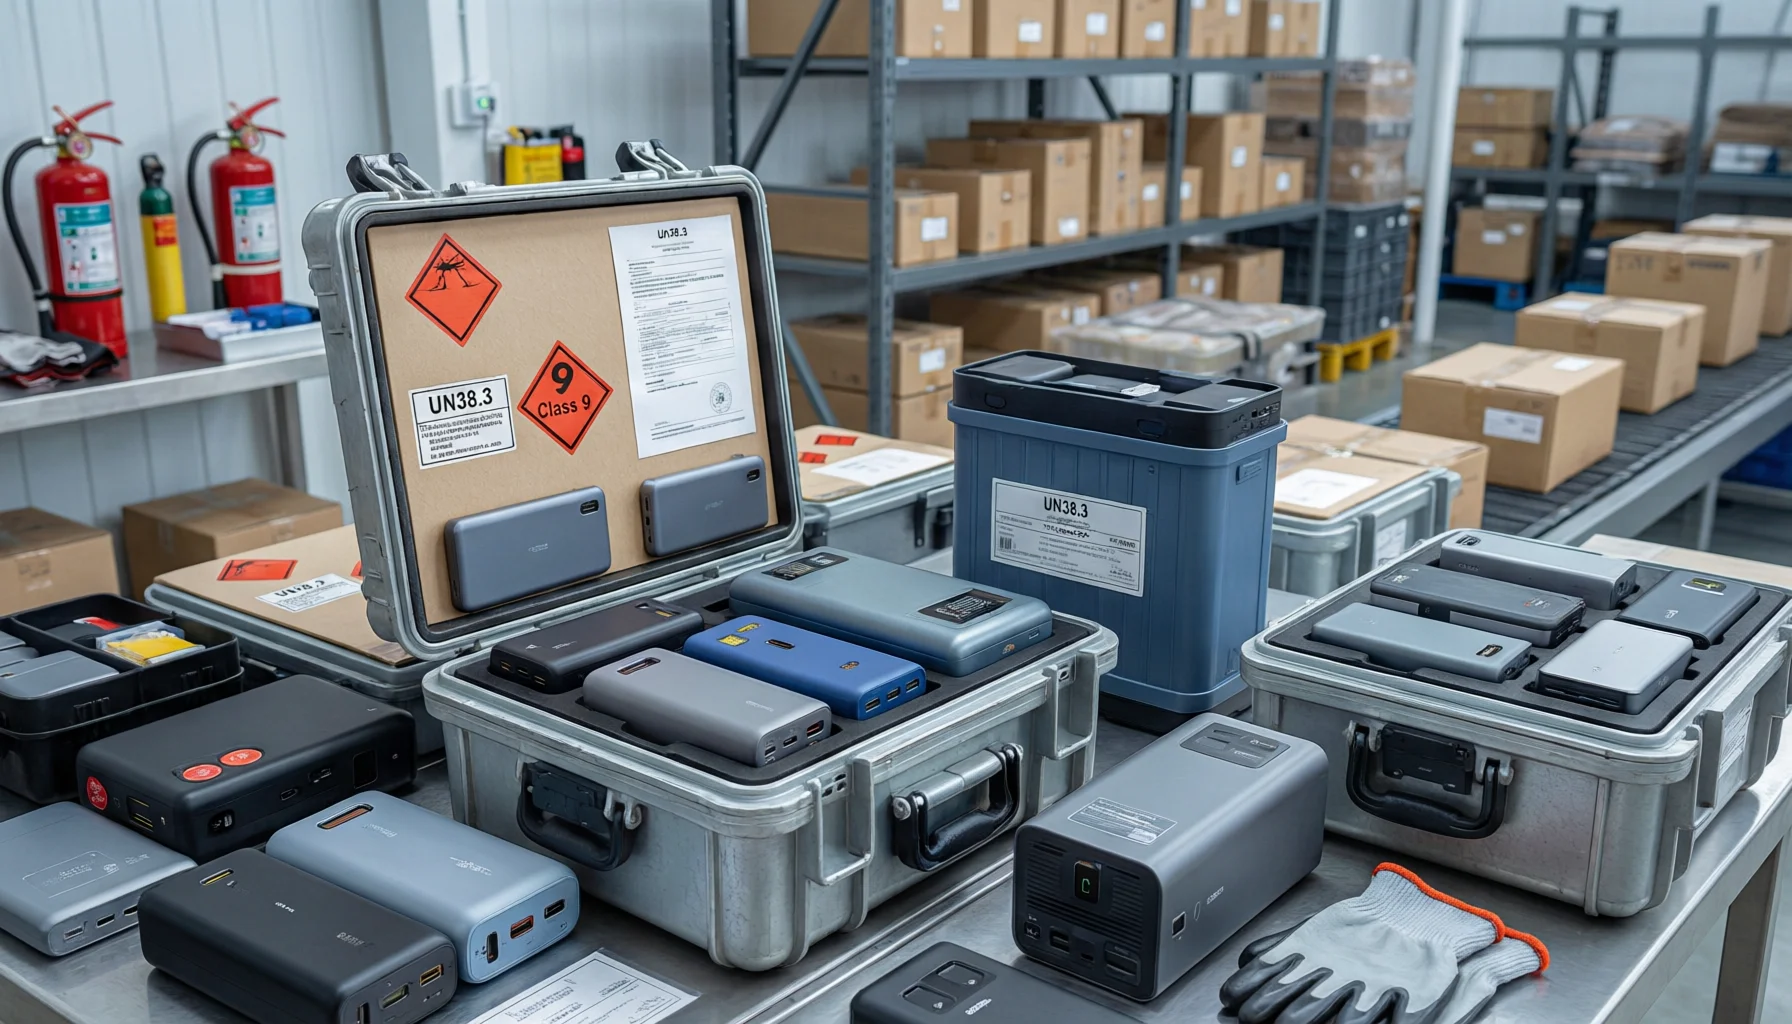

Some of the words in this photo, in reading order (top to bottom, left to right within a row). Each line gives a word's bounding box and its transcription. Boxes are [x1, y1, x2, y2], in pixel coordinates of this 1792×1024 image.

[551, 361, 574, 395] 9
[428, 387, 493, 414] UN38.3
[537, 400, 578, 419] Class
[581, 394, 591, 411] 9
[1044, 495, 1088, 518] UN38.3
